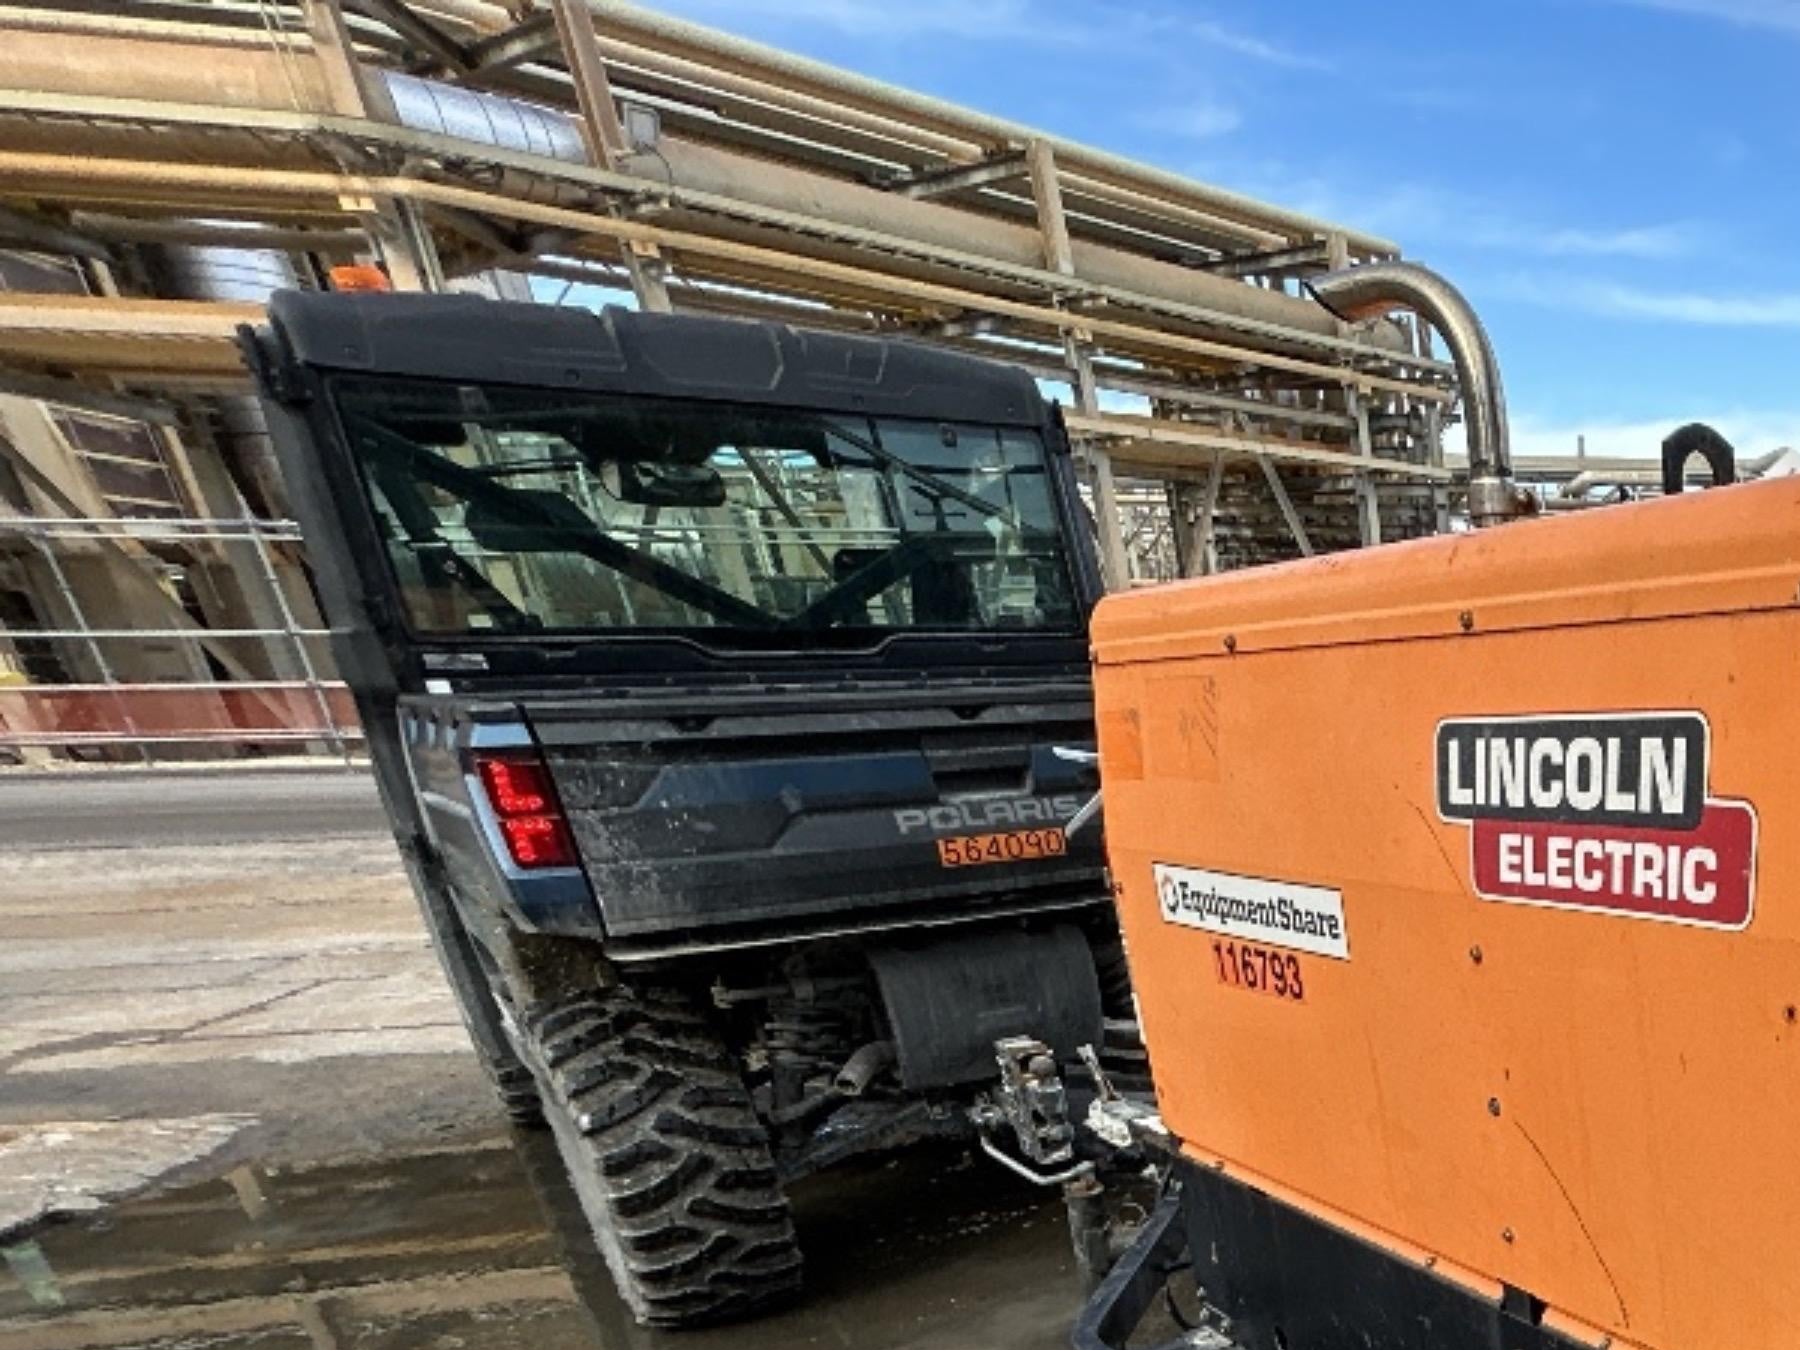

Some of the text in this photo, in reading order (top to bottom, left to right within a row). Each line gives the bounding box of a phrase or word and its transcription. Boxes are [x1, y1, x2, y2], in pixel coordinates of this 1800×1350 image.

[1447, 735, 1688, 815] LINCOLN
[894, 796, 1079, 834] POLARIS
[943, 829, 1063, 866] 564090
[1497, 832, 1717, 904] ELECTRIC
[1178, 881, 1341, 940] EquipmentShare
[1213, 941, 1304, 1000] 116793
